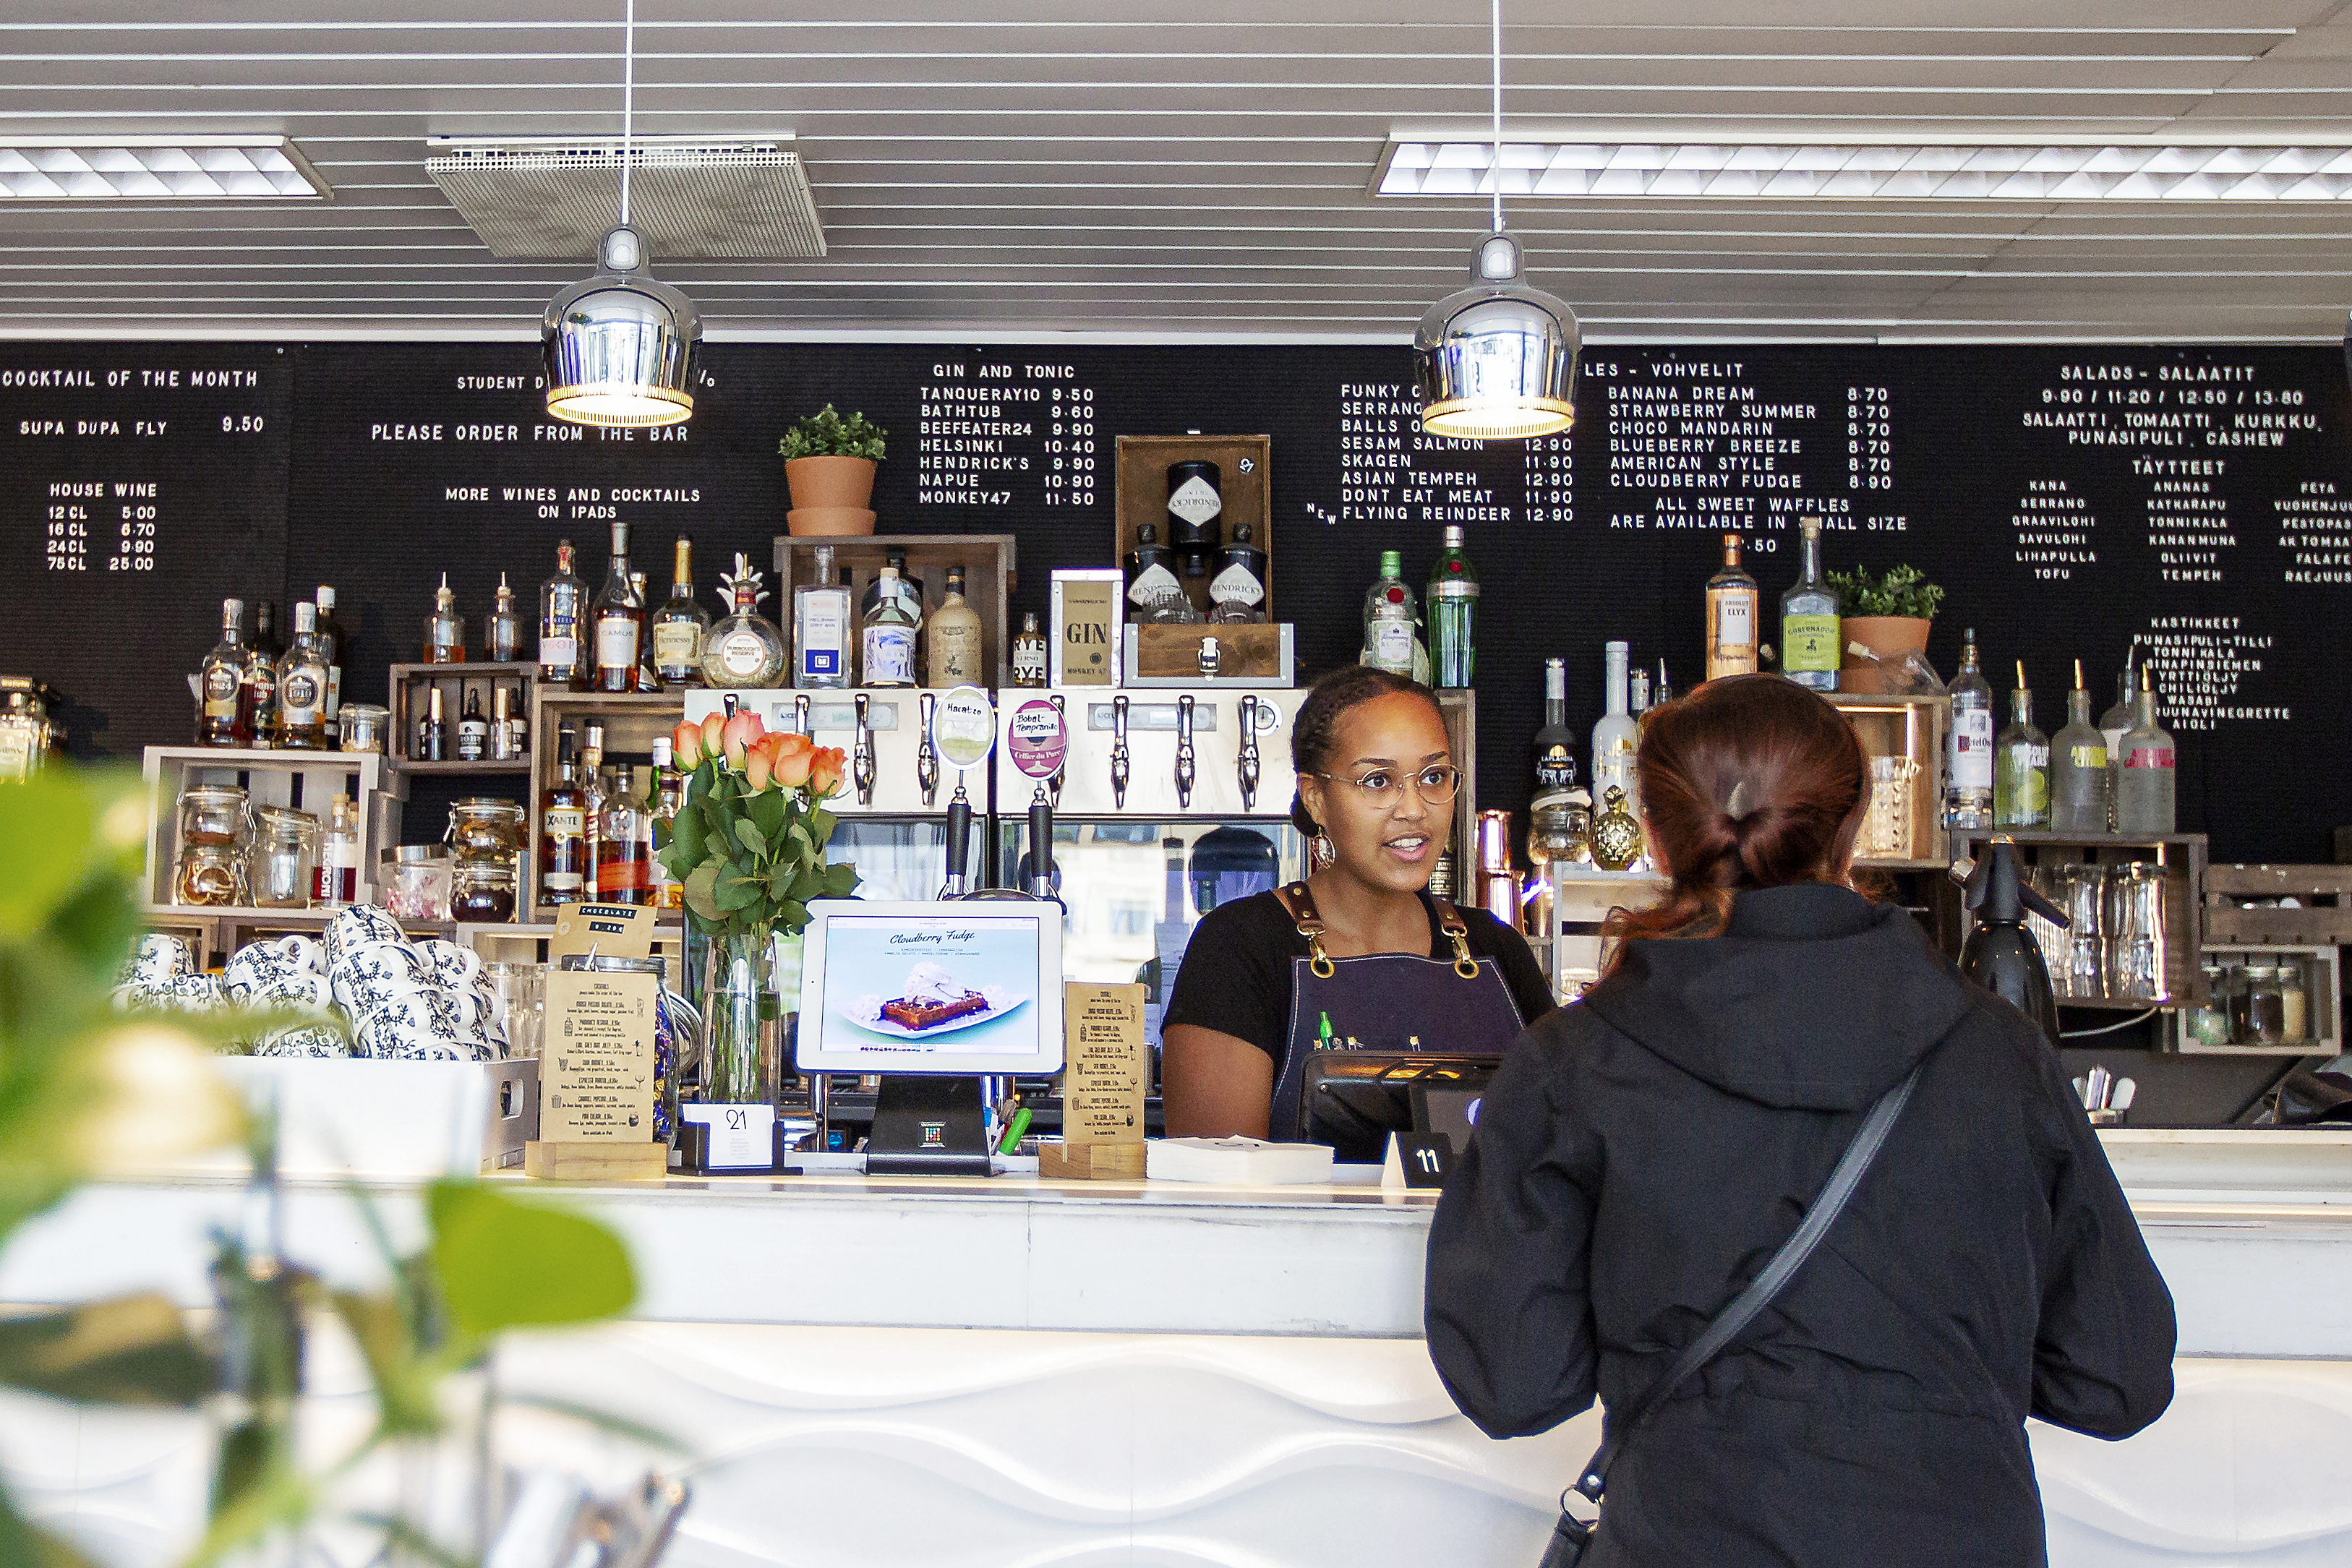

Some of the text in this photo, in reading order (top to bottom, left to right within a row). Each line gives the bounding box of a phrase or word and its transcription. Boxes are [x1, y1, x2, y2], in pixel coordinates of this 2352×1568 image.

[933, 364, 1074, 378] GIN AND TONIC
[1651, 362, 1743, 377] VOHVELIT
[2061, 365, 2254, 382] SALADS SALAATIT
[1, 369, 257, 387] COCKTAIL OF THE MONTH
[457, 376, 525, 390] STUDENT
[920, 386, 1093, 402] TANQUERAY10 9.50
[1341, 383, 1400, 398] FUNKY
[1608, 385, 1888, 402] BANANA DREAM 8.70
[2042, 388, 2304, 406] 9.90 11.20 12.50 13.80
[920, 403, 1093, 419] BATHTUB 9.60
[1342, 403, 1421, 415] SERRANO
[1609, 403, 1889, 419] STRAWBERRY SUMMER 8.70
[20, 415, 264, 436] SUPA DUPA FLY 9.50
[372, 424, 687, 442] PLEASE ORDER FROM THE BAR
[920, 421, 1094, 437] BEEFEATER24 9.90
[1341, 419, 1398, 433] BALLS
[1609, 420, 1890, 437] CHOCO MANDARIN 8.70
[920, 438, 1095, 454] HELSINKI 10.40
[1341, 435, 1572, 452] SESAM SALMON 12.90
[1610, 438, 1890, 455] BLUEBERRY BREEZE 8.70
[2206, 431, 2284, 447] CASHEW
[919, 455, 1095, 471] HENDRICK'S 9.90
[1341, 453, 1573, 469] SKAGEN 11.90
[1610, 455, 1891, 472] AMERICAN STYLE 8.70
[2131, 455, 2225, 476] TÄYTTEET
[919, 473, 1095, 489] NAPUE 10.90
[1341, 470, 1573, 487] ASIAN TEMPEH 12.90
[1610, 473, 1891, 489] CLOUDBERRY FUDGE 8.90
[2030, 480, 2066, 492] KANA
[50, 482, 158, 498] HOUSE WINE
[445, 487, 701, 502] MORE WINES AND COCKTAILS
[2153, 481, 2210, 493] ANANAS
[2300, 481, 2335, 494] FETA
[919, 490, 1094, 505] MONKEY47 11.50
[1343, 488, 1573, 505] DONT EAT MEAT 11.90
[2020, 497, 2085, 510] SERRANO
[48, 505, 156, 520] 12 CL 5.00
[538, 505, 617, 519] ON IPADS
[1655, 497, 1849, 513] ALL SWEET WAFFLES
[1343, 505, 1573, 522] FLYING REINDEER 12.90
[68, 522, 87, 537] CL
[121, 522, 155, 537] 6.70
[1610, 514, 1907, 531] ARE AVAILABLE IN ALL SIZE
[121, 539, 154, 554] 9.90
[1740, 539, 1776, 552] .50
[2301, 536, 2352, 547] TOMAA
[109, 556, 154, 571] 25.00
[2035, 567, 2069, 580] TOFU
[1066, 623, 1106, 644] GIN
[1014, 640, 1044, 651] RYE
[1014, 667, 1043, 679] RYE
[582, 908, 633, 917] CHOCOLATE
[890, 930, 975, 945] Cloudberry Fudge
[726, 1109, 747, 1130] 21
[1416, 1149, 1440, 1173] 11
